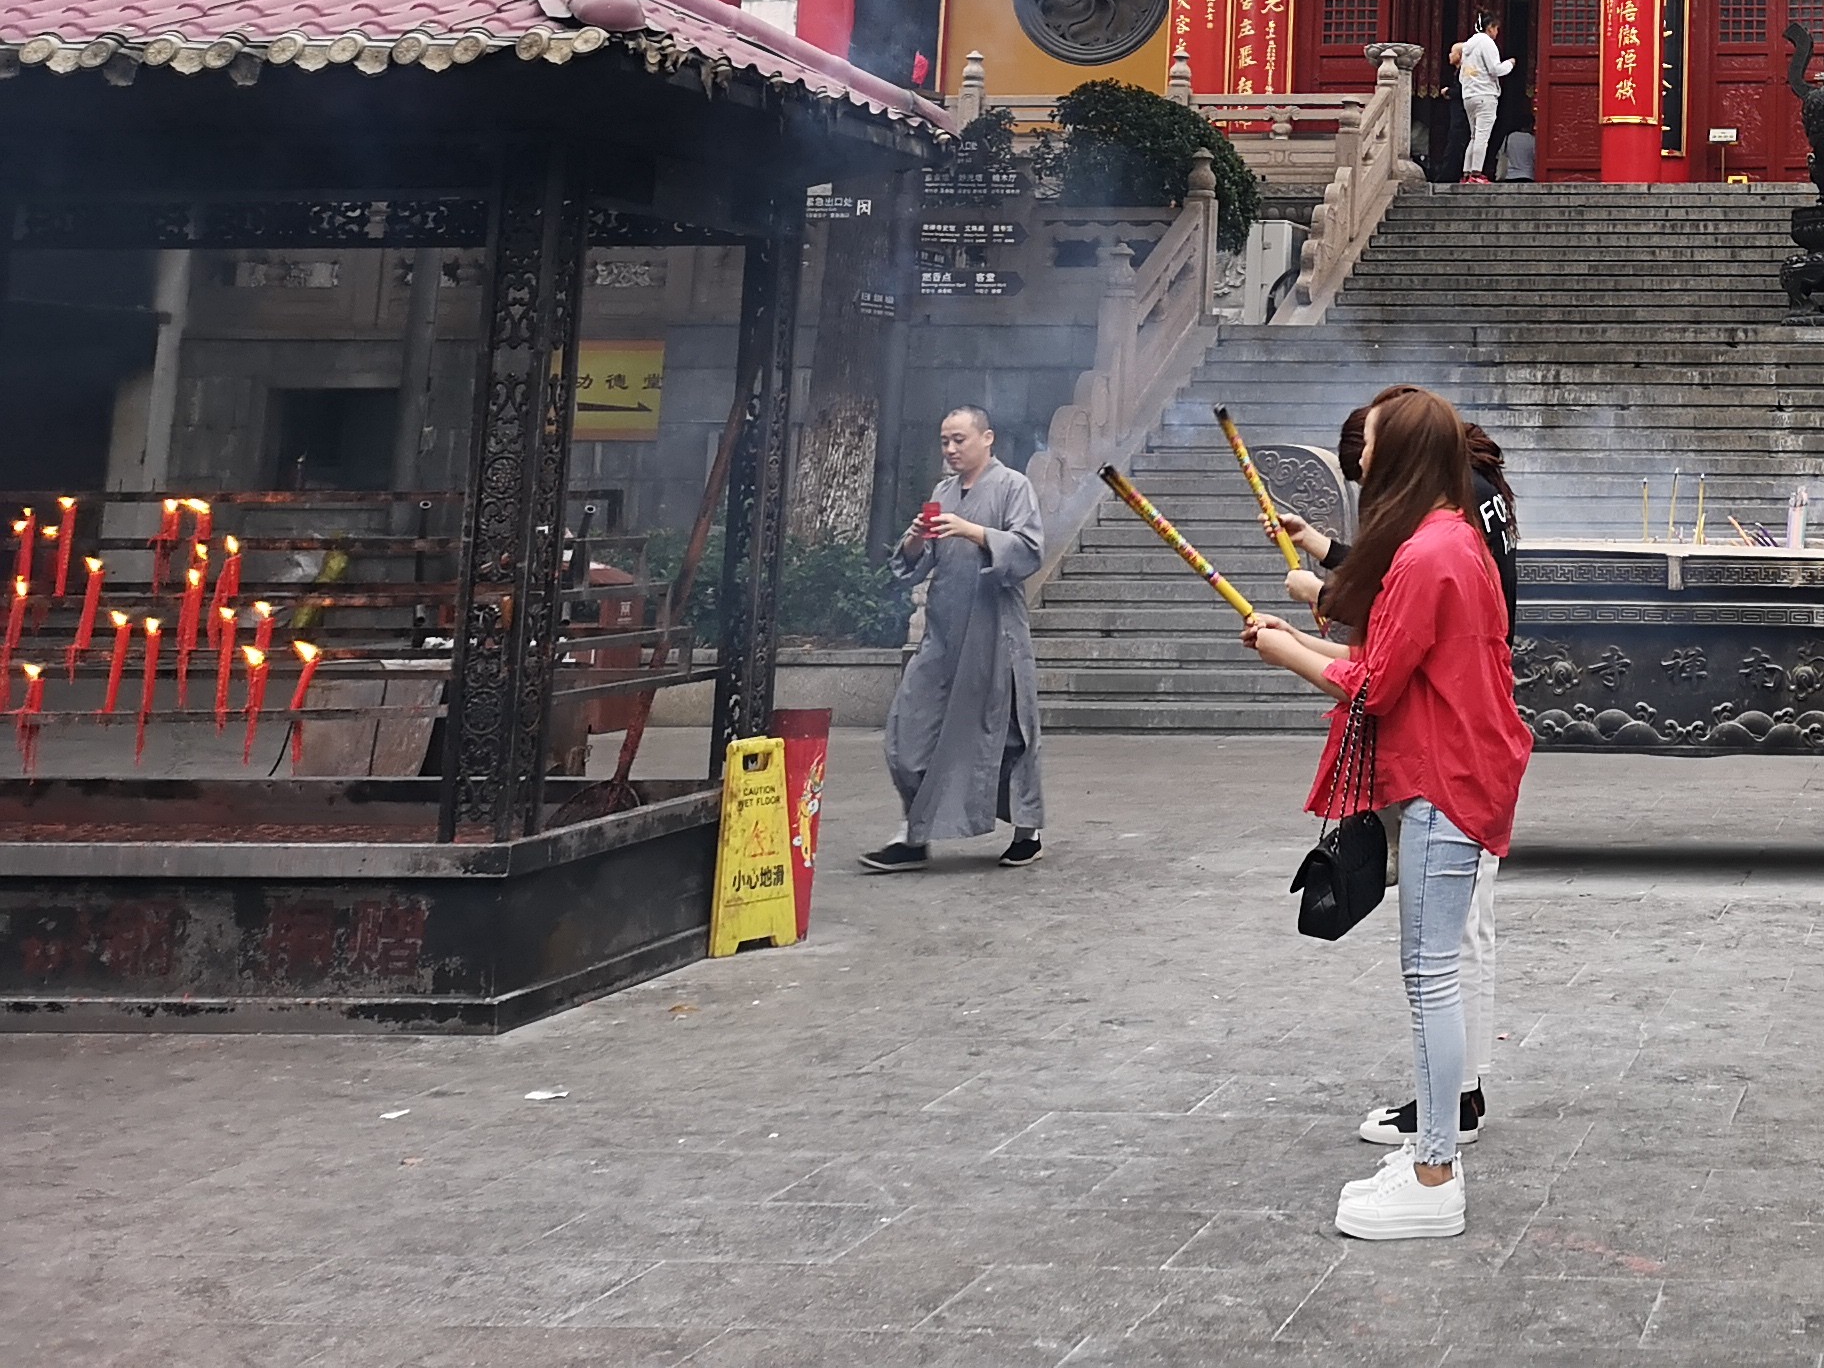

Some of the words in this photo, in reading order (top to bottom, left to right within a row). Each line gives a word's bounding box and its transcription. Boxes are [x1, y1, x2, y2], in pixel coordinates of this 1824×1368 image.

[743, 785, 776, 797] CAUTION
[757, 795, 781, 807] FLOOR
[732, 865, 784, 892] 小心地滑
